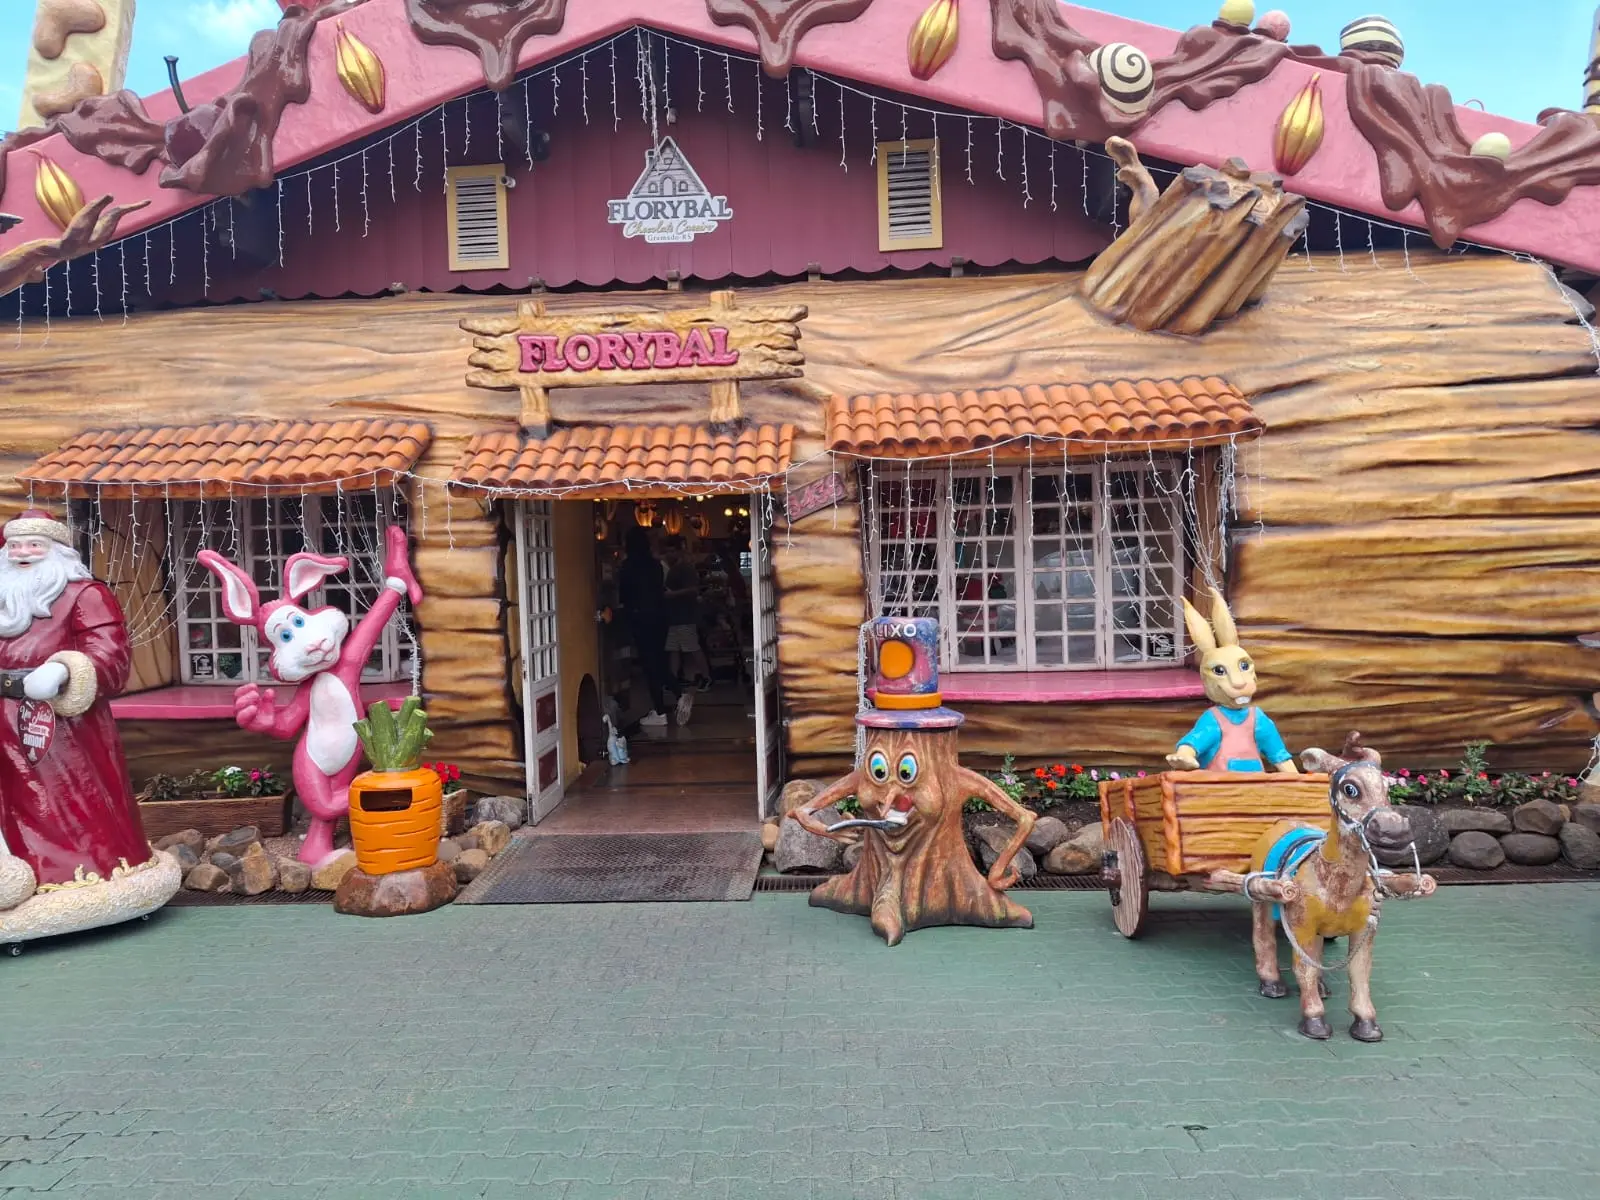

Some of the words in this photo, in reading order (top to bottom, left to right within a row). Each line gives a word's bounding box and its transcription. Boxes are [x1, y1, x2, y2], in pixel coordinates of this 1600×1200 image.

[608, 198, 731, 221] FLORYBAL
[626, 221, 673, 236] Chocolate
[517, 327, 740, 372] FLORYBAL
[876, 623, 917, 637] LIXO
